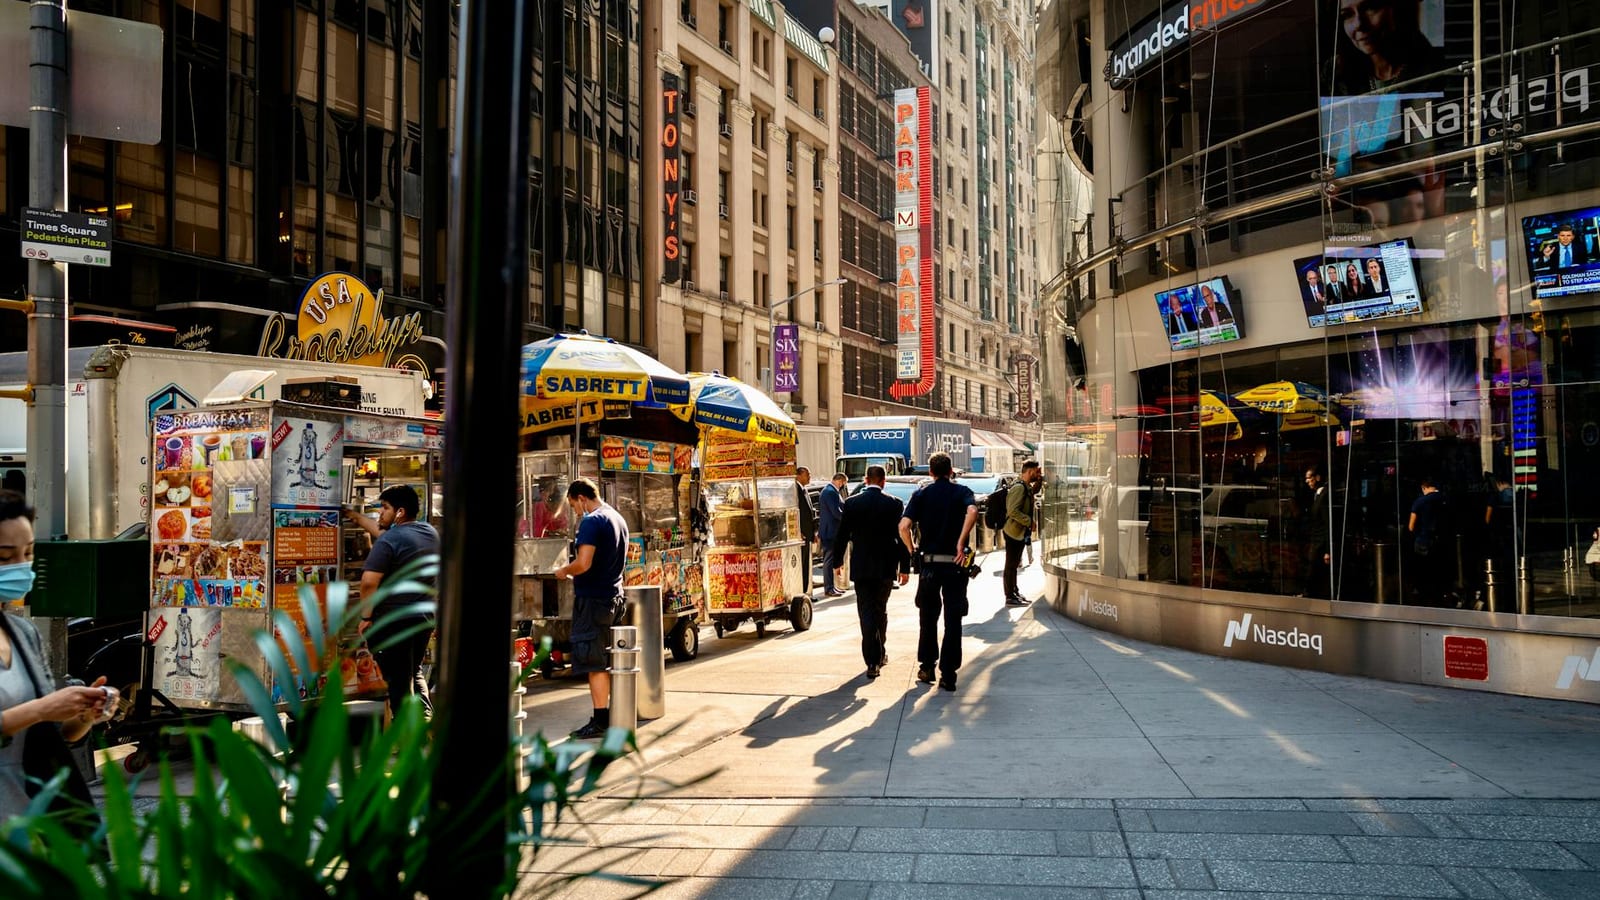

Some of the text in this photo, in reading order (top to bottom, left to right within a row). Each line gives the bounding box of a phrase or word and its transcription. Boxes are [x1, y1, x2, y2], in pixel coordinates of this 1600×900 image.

[1114, 4, 1190, 83] branded
[896, 103, 914, 194] PARK
[663, 90, 679, 260] TONY'S
[26, 219, 98, 237] Times Square
[26, 230, 107, 248] Pedestrian Plaza
[304, 278, 351, 324] USA
[898, 245, 916, 335] PARK
[128, 331, 147, 345] The
[174, 323, 214, 347] Brooklyn
[257, 287, 424, 369] Brooklyn
[775, 338, 798, 352] SIX
[546, 377, 642, 395] SABRETT
[775, 372, 798, 387] SIX
[1018, 361, 1030, 417] BREWERY
[173, 411, 254, 429] BREAKFAST
[271, 425, 289, 447] NEW!
[861, 431, 905, 440] WESCO
[934, 433, 964, 453] WESCO
[725, 560, 745, 575] Roasted
[745, 559, 757, 574] Nuts
[1089, 597, 1118, 621] Nasdaq
[1253, 623, 1323, 656] Nasdaq
